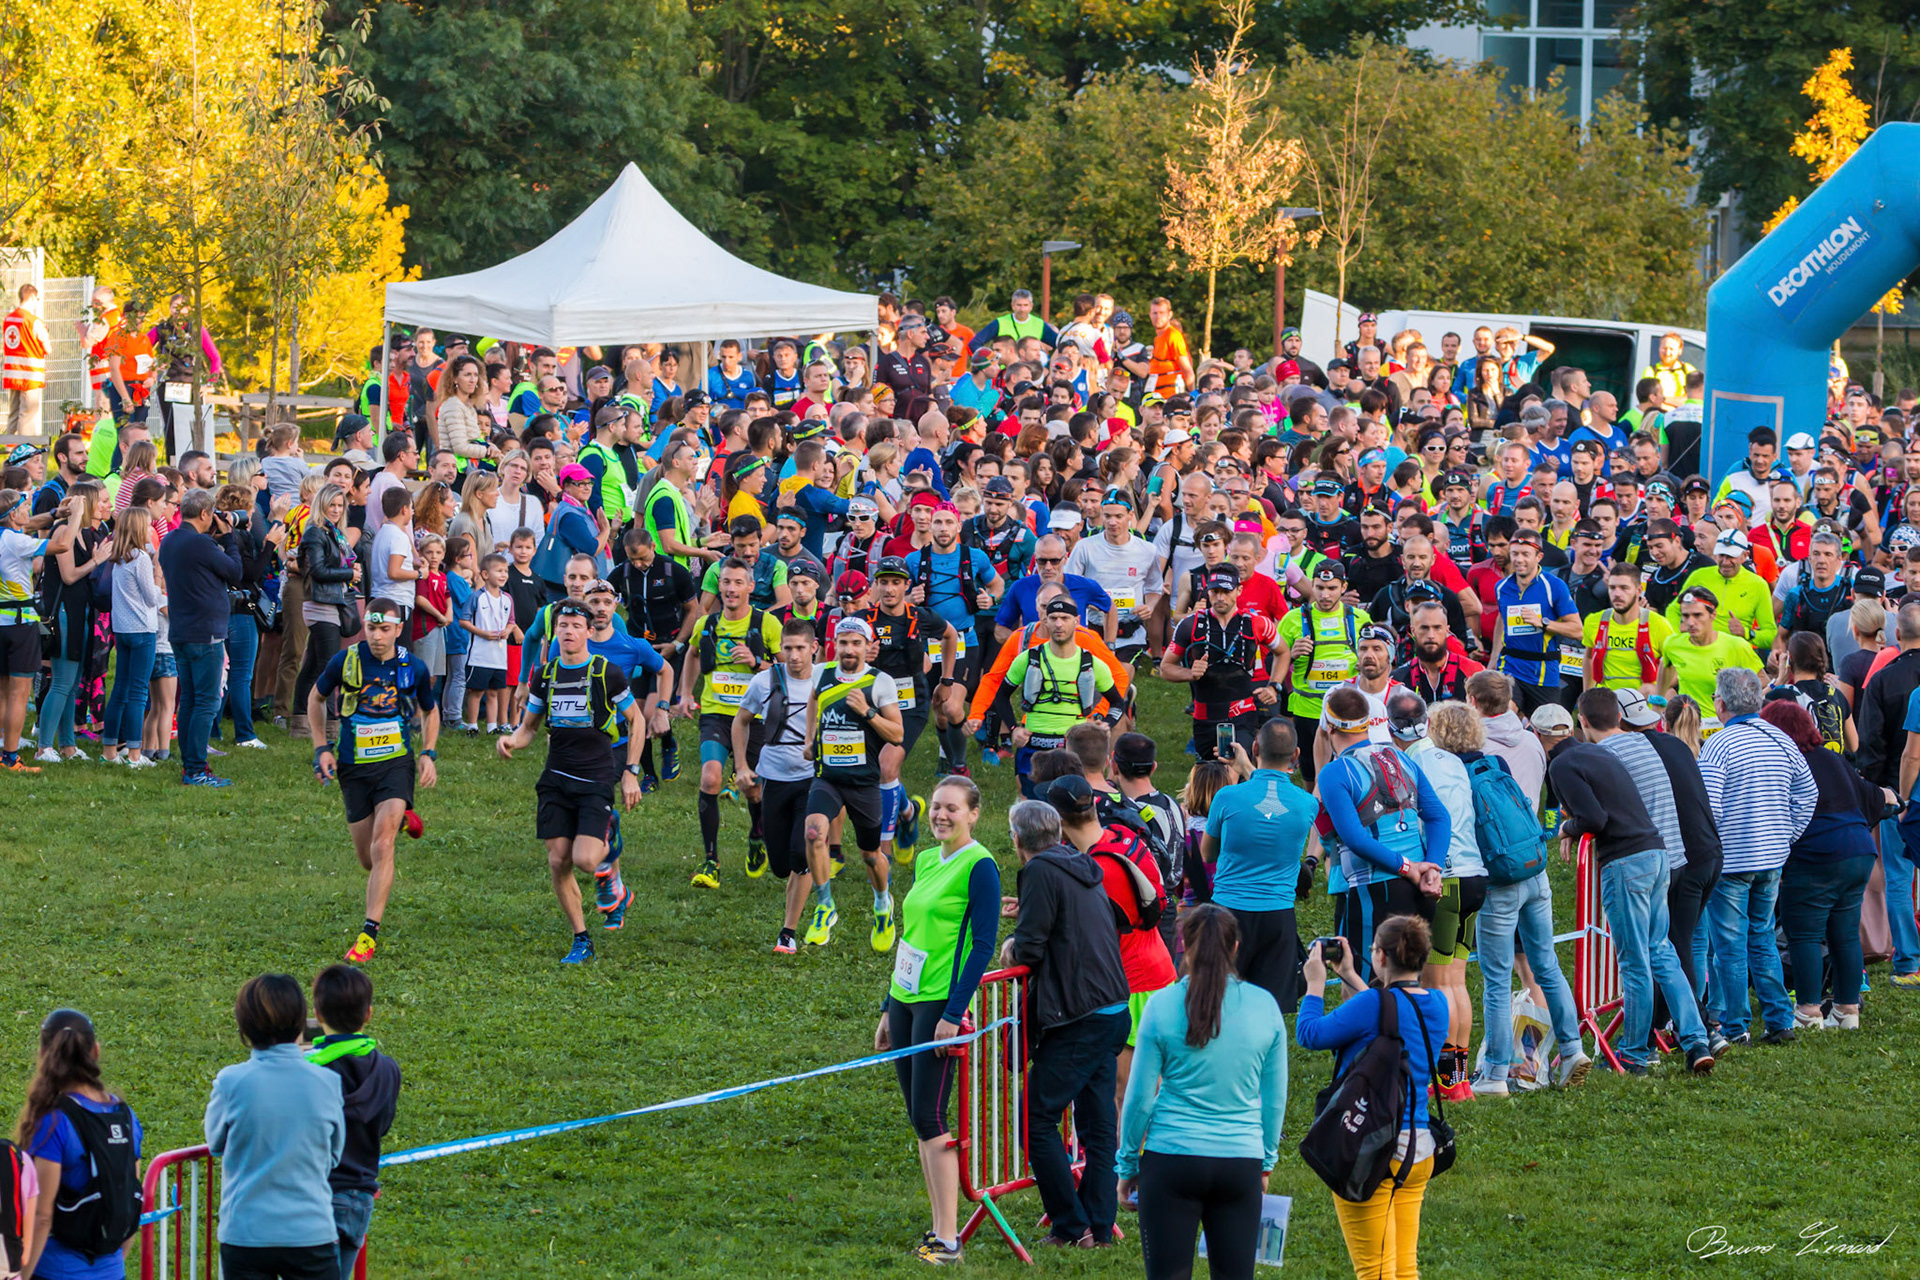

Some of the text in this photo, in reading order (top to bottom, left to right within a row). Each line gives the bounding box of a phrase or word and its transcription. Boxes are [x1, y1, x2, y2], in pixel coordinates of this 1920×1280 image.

[1825, 231, 1871, 275] HOUDEMONT
[1767, 216, 1863, 307] DECATHLON
[432, 579, 439, 591] 7
[1320, 671, 1339, 680] 164
[723, 684, 743, 694] 017
[369, 735, 390, 746] 172
[833, 744, 854, 755] 329
